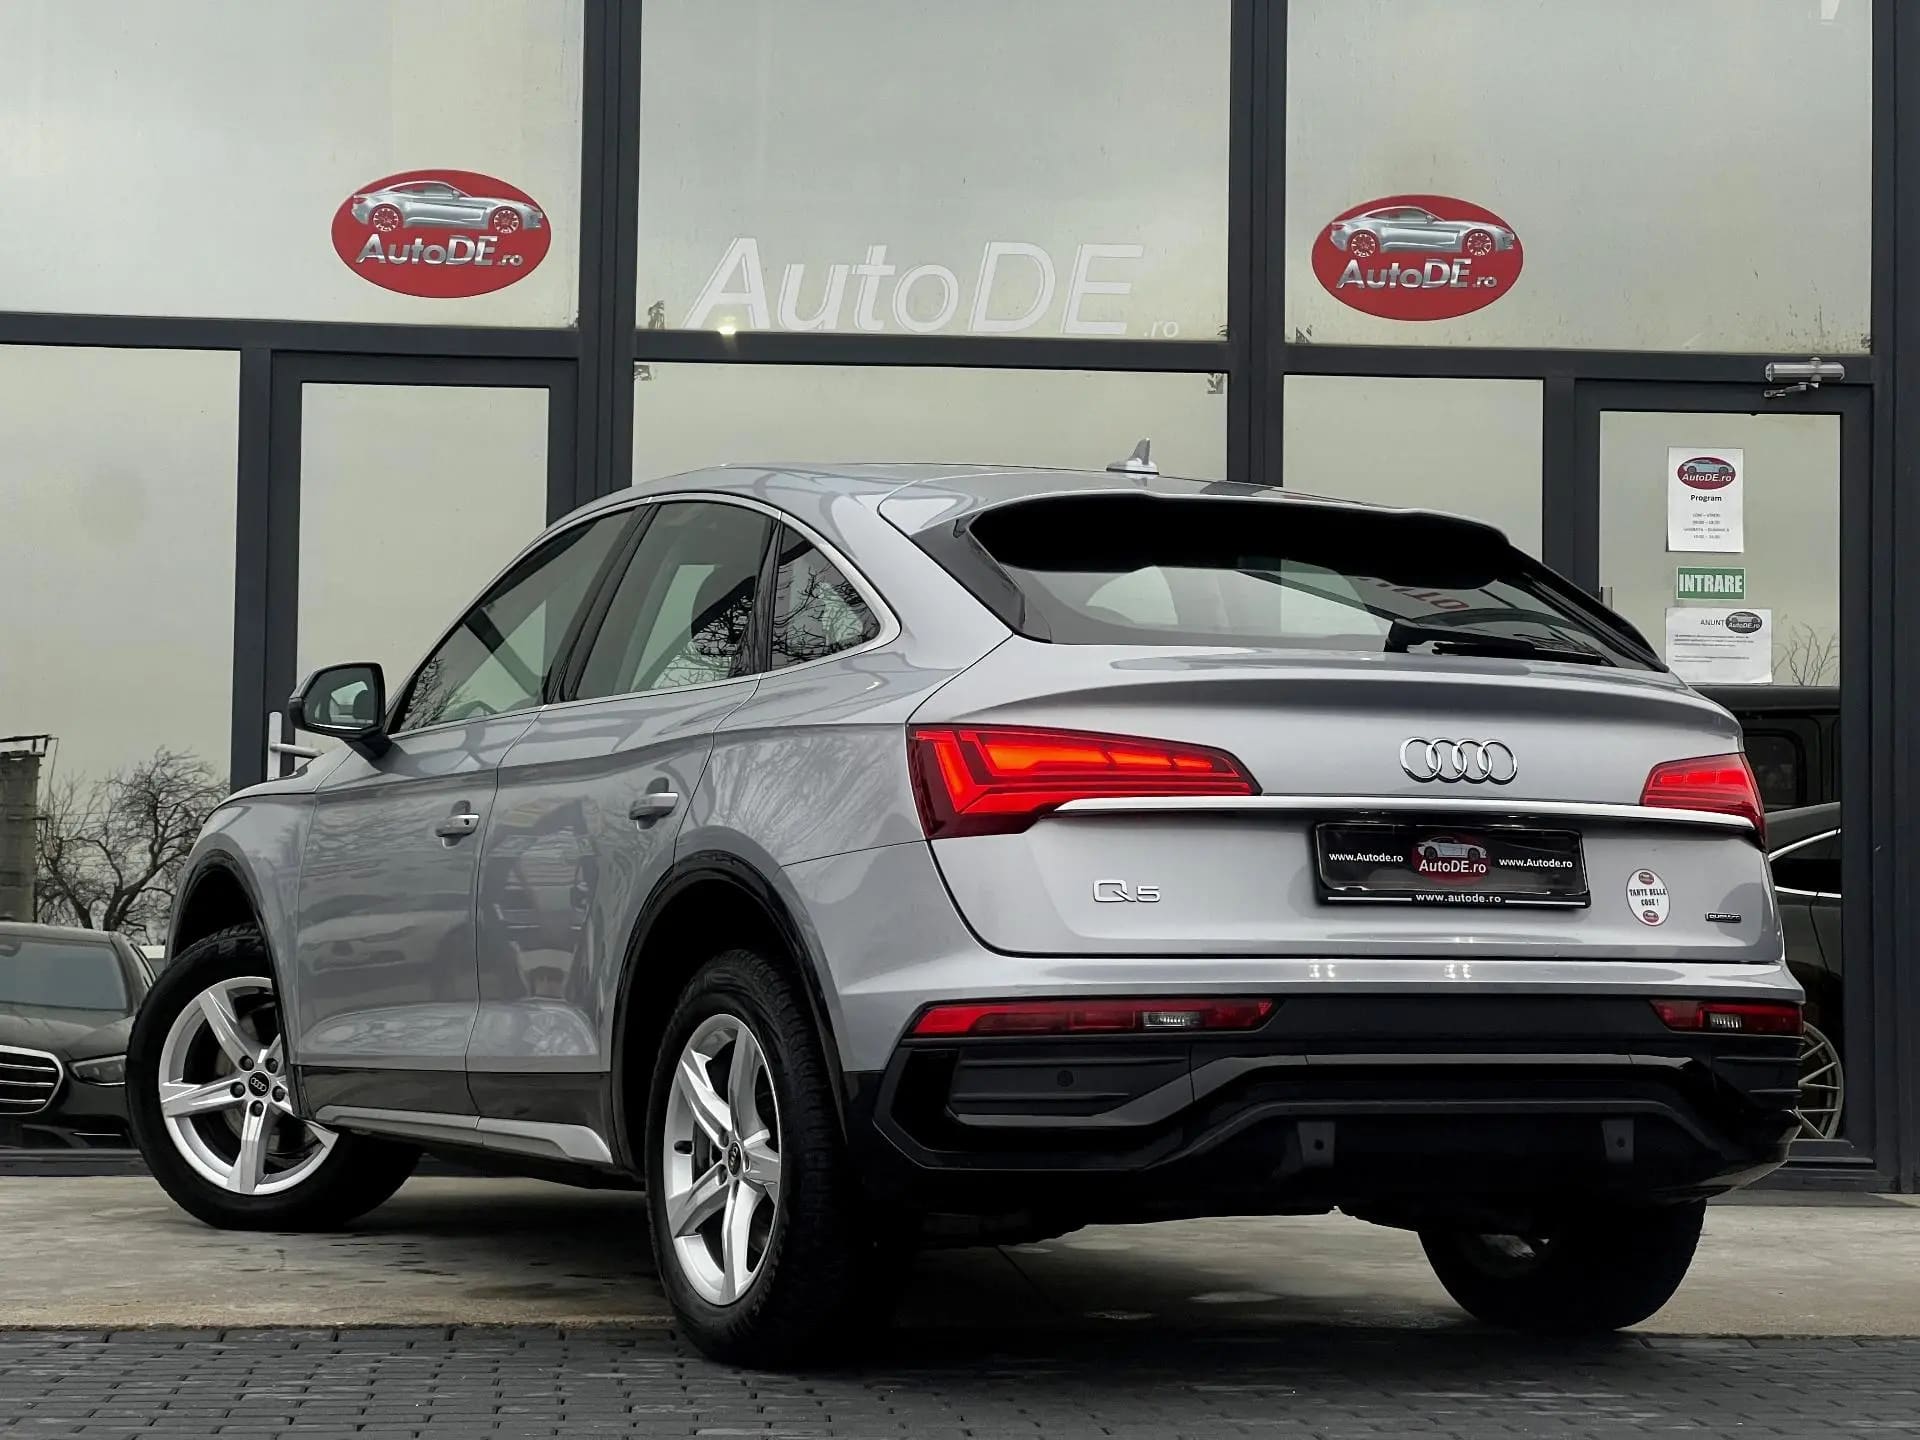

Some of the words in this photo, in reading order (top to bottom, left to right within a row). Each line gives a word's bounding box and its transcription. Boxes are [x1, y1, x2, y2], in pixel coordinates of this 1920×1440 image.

[1690, 494, 1722, 503] Program
[1678, 574, 1743, 593] INTRARE
[1328, 851, 1404, 864] www.Autode.ro
[1418, 858, 1487, 875] AutoDE.ro
[1498, 857, 1573, 869] www.Autode.ro
[1092, 879, 1161, 903] Q5
[1628, 888, 1648, 897] TANTE
[1415, 892, 1502, 904] www.autode.ro
[1640, 898, 1656, 906] COSE
